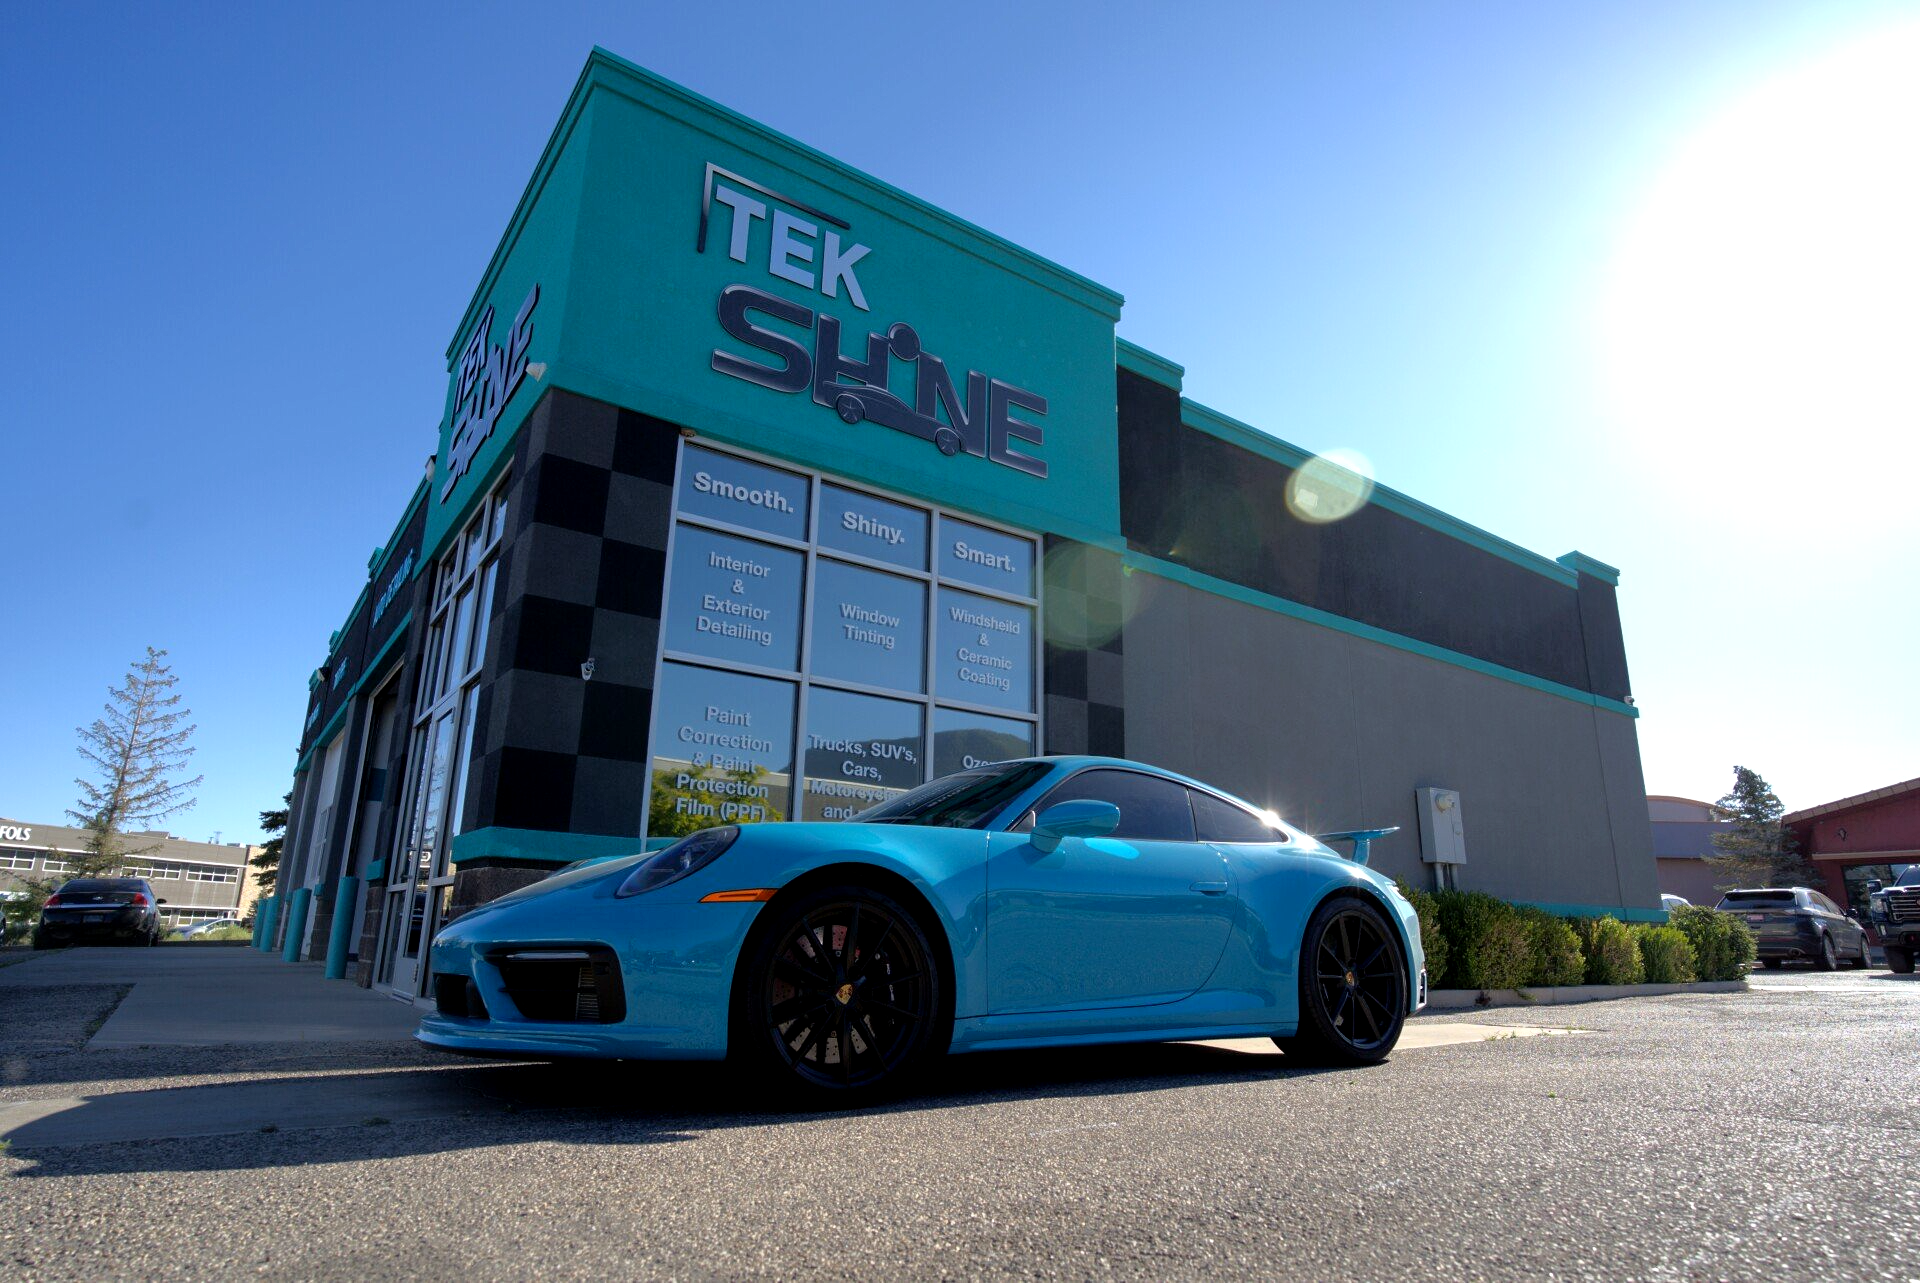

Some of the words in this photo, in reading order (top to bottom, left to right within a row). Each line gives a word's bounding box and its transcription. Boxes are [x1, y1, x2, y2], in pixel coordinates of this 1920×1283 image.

[715, 184, 873, 312] TEK
[712, 284, 1048, 478] SHINE
[694, 471, 795, 514] Smooth.
[842, 510, 906, 544] Shiny.
[709, 550, 771, 579] Interior
[954, 540, 1017, 573] Smart.
[732, 578, 745, 595] &
[703, 594, 771, 622] Exterior
[840, 602, 900, 628] Window
[949, 606, 1021, 636] Windsheild
[696, 615, 772, 647] Detailing
[843, 624, 895, 650] Tinting
[977, 631, 990, 647] &
[957, 647, 1013, 671] Ceramic
[957, 666, 1011, 691] Coating
[705, 705, 752, 728] Paint
[677, 725, 773, 753] Correction
[808, 734, 867, 758] Trucks,
[691, 752, 705, 768] &
[710, 752, 757, 774] Paint
[842, 760, 882, 782] Cars,
[676, 772, 769, 799] Protection
[675, 797, 715, 817] Film
[720, 801, 766, 823] (PPF)
[823, 804, 854, 819] and
